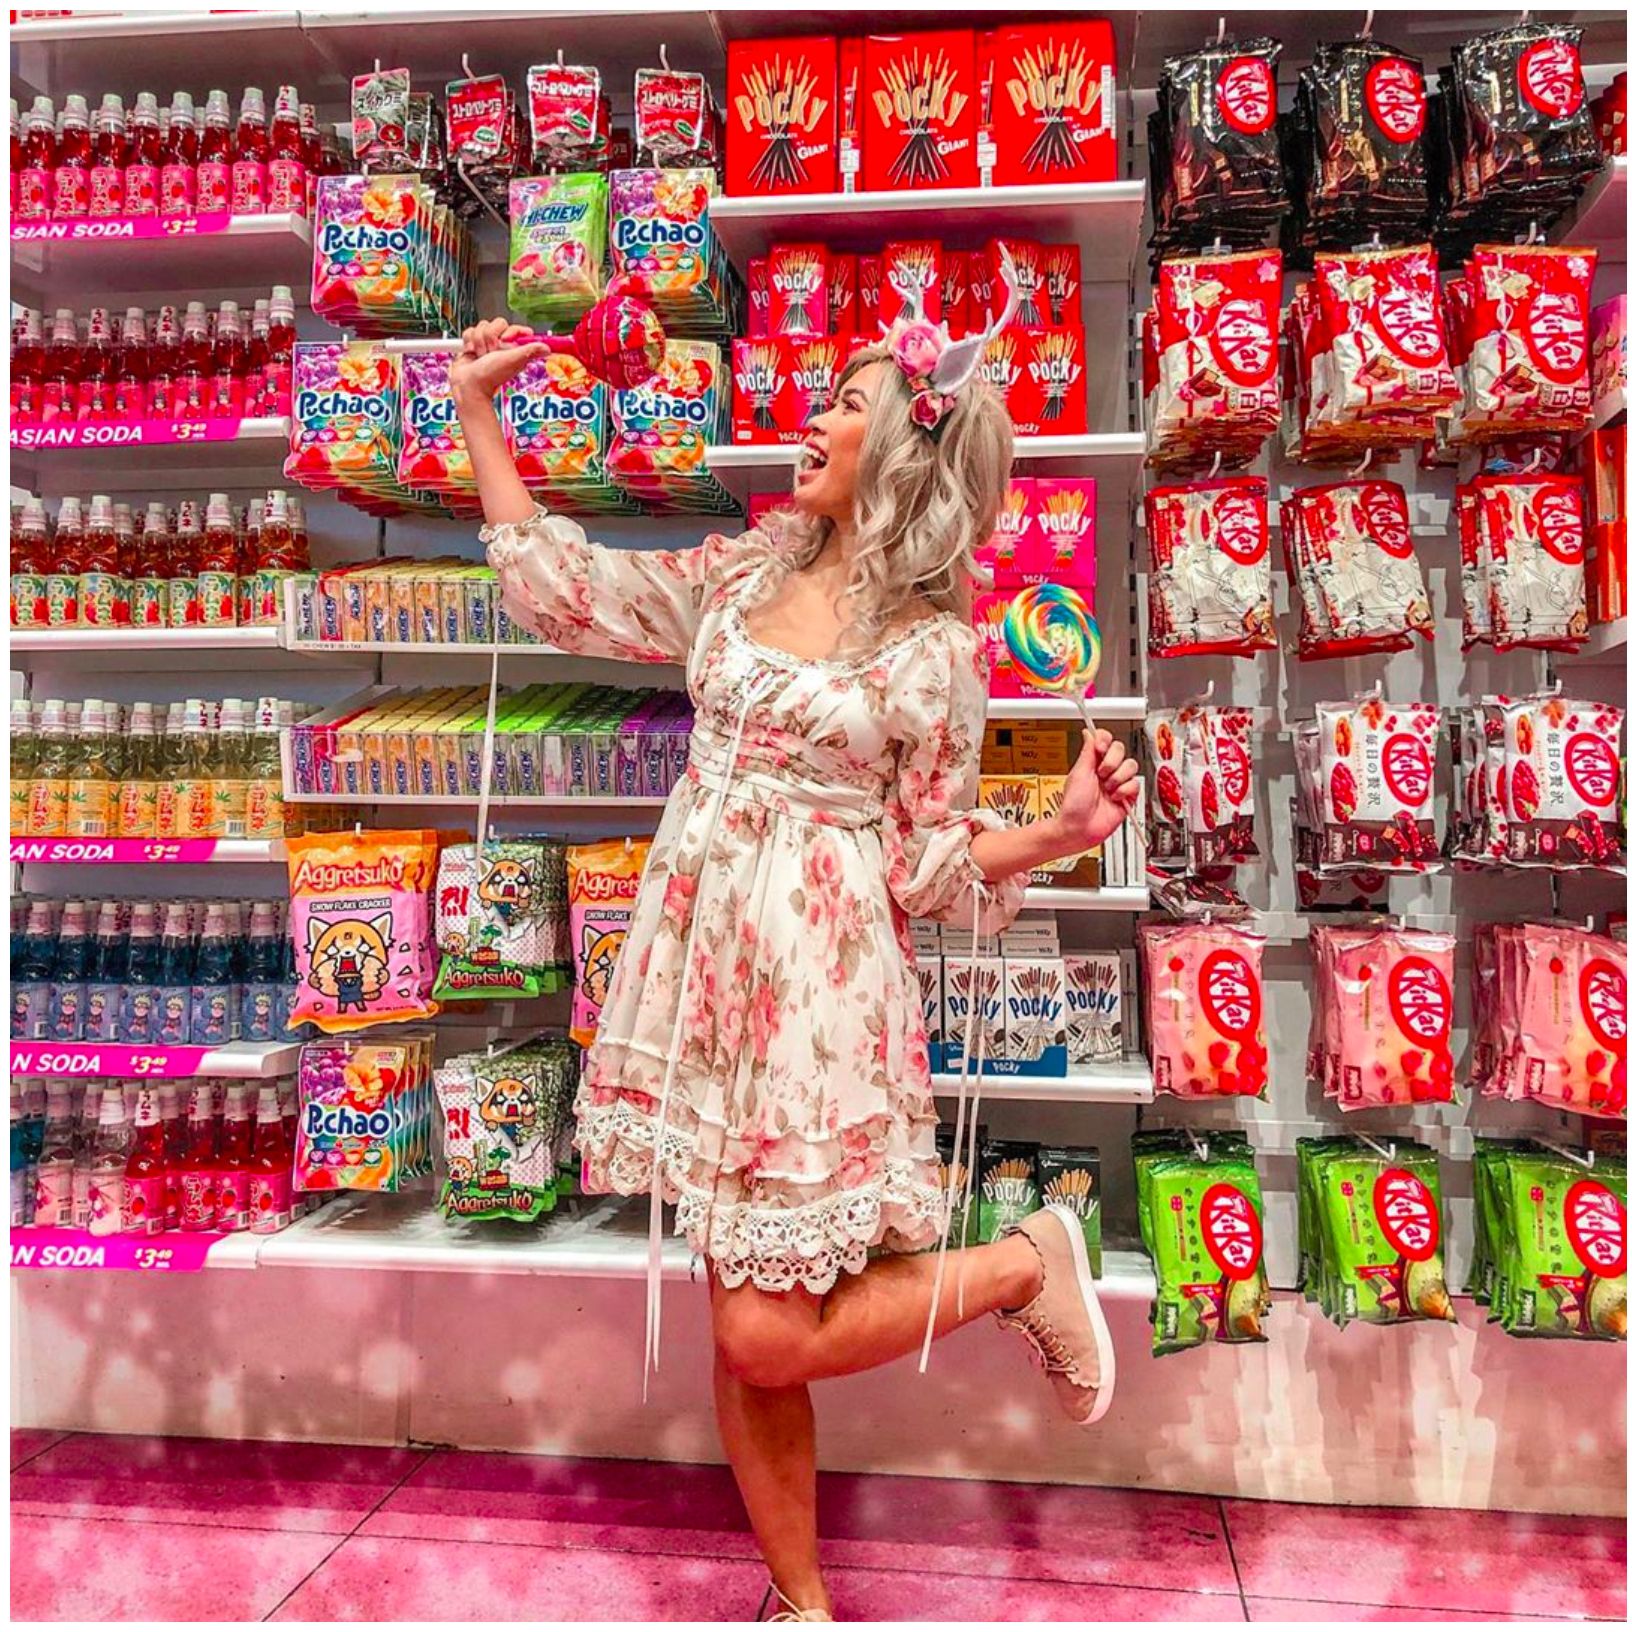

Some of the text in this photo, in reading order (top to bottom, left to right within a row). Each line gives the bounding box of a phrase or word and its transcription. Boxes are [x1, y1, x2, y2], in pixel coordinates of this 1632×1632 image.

[872, 82, 969, 129] POCKY
[1005, 70, 1102, 117] POCKY
[734, 88, 829, 133] POCKY
[72, 222, 135, 236] SODA
[772, 270, 823, 293] POCKY
[735, 367, 786, 394] POCKY
[791, 366, 834, 394] POCK
[1027, 360, 1082, 385] POCKY
[10, 427, 75, 445] ASIAN
[80, 425, 143, 441] SODA
[1037, 511, 1092, 535] POCKY
[50, 843, 115, 859] SODA
[294, 857, 404, 890] Aggretsuko
[576, 866, 640, 898] Aggrets
[1031, 872, 1054, 885] OCKY
[444, 967, 525, 990] Aggretsuko
[1007, 993, 1063, 1021] POCKY
[1065, 987, 1119, 1014] POCKY
[36, 1053, 101, 1072] SODA
[982, 1179, 1037, 1207] POCKY
[39, 1246, 105, 1266] SODA
